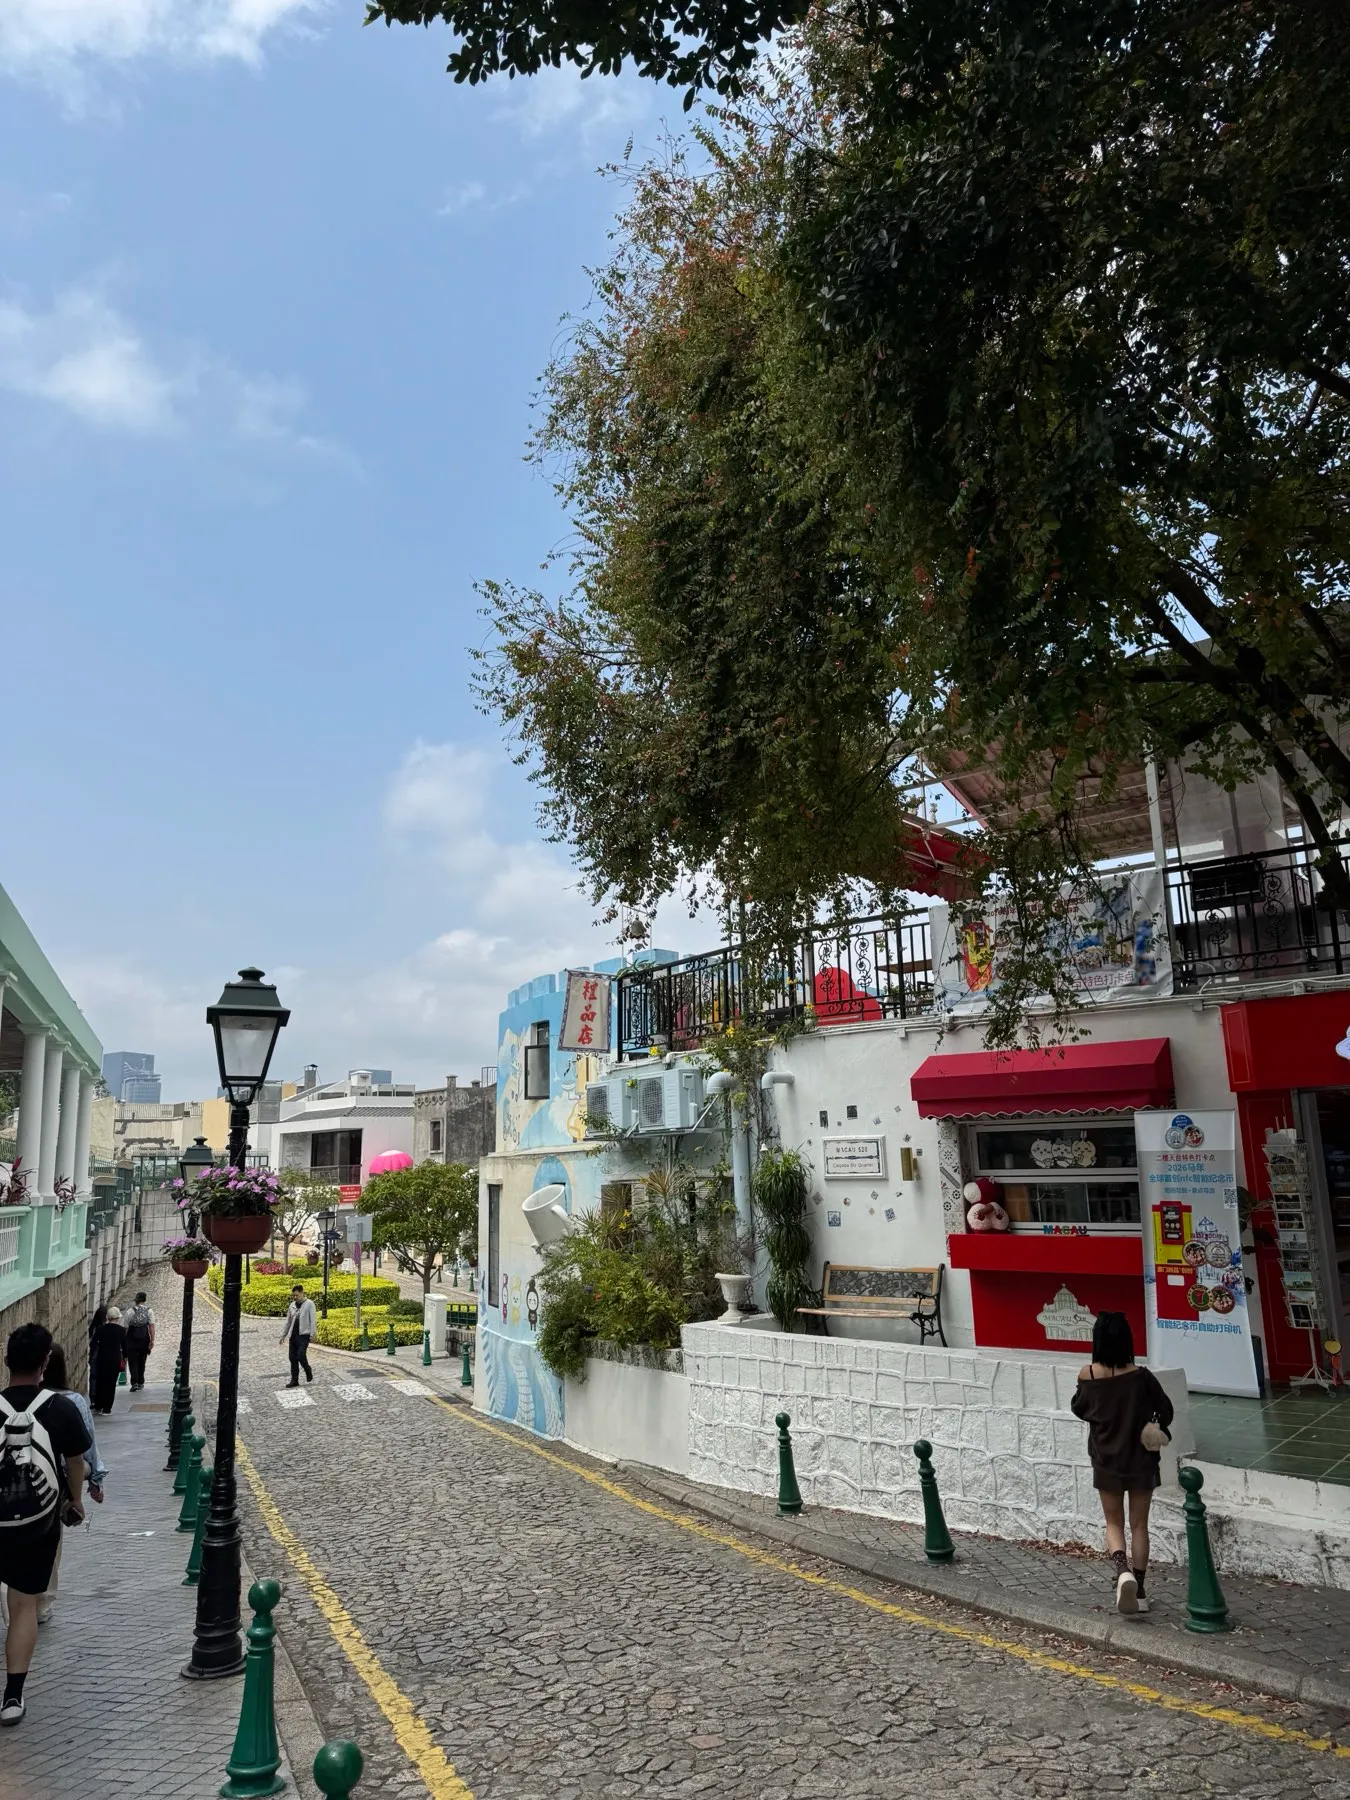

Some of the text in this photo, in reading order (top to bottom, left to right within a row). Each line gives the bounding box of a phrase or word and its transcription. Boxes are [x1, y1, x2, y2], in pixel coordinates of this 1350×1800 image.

[1168, 1163, 1205, 1172] 2026马年
[1156, 1319, 1242, 1335] 智能纪念币自助打印机
